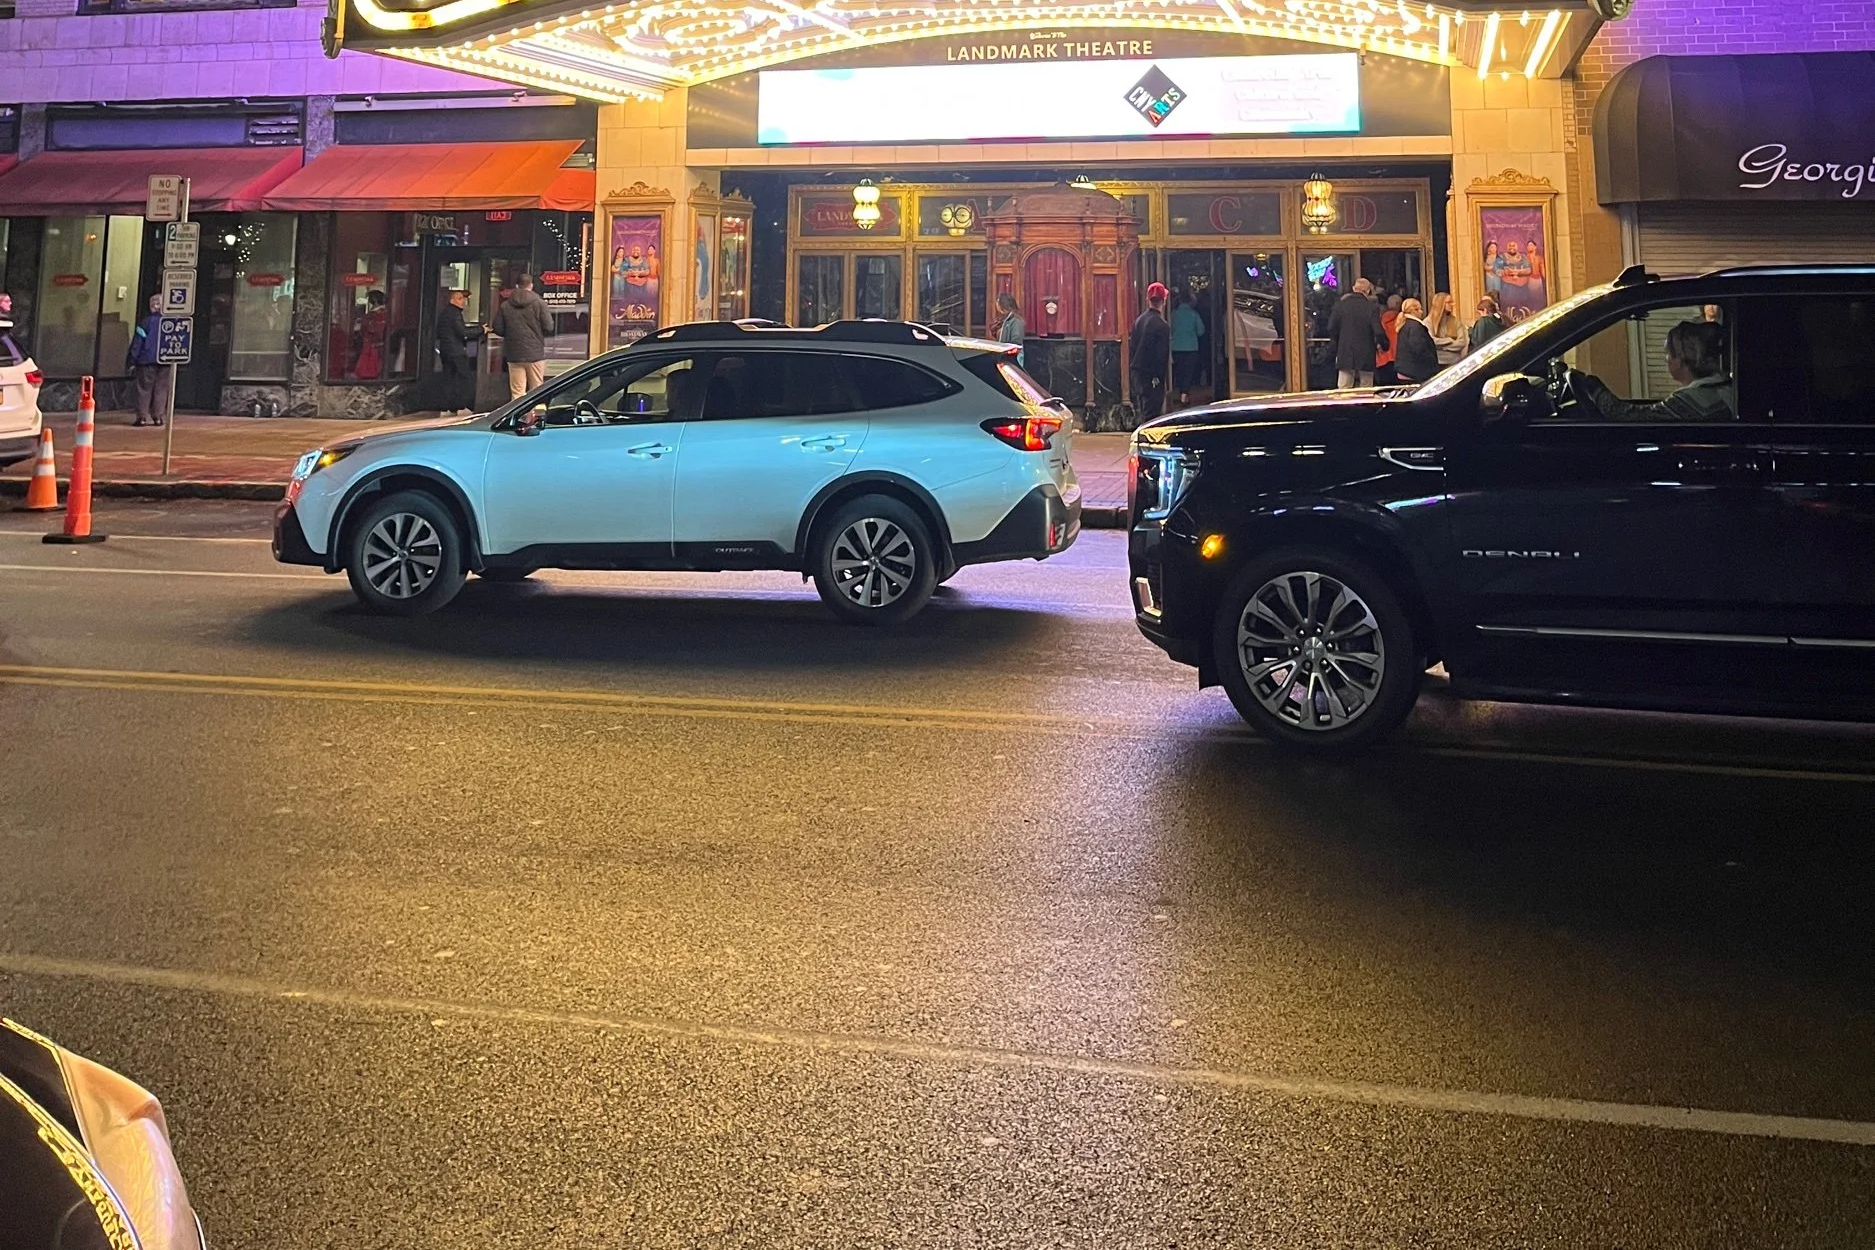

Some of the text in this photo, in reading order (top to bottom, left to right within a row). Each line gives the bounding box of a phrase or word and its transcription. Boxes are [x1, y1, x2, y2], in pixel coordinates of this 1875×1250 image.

[947, 40, 1153, 62] LANDMARK THEATRE
[1128, 86, 1156, 112] CNY
[1147, 87, 1181, 124] ARTS
[158, 179, 171, 189] NO
[1208, 196, 1242, 233] C
[1341, 195, 1377, 232] D
[169, 225, 176, 240] 2
[615, 304, 656, 320] Aladdin
[160, 347, 188, 355] PARK
[1462, 550, 1580, 559] DENALI
